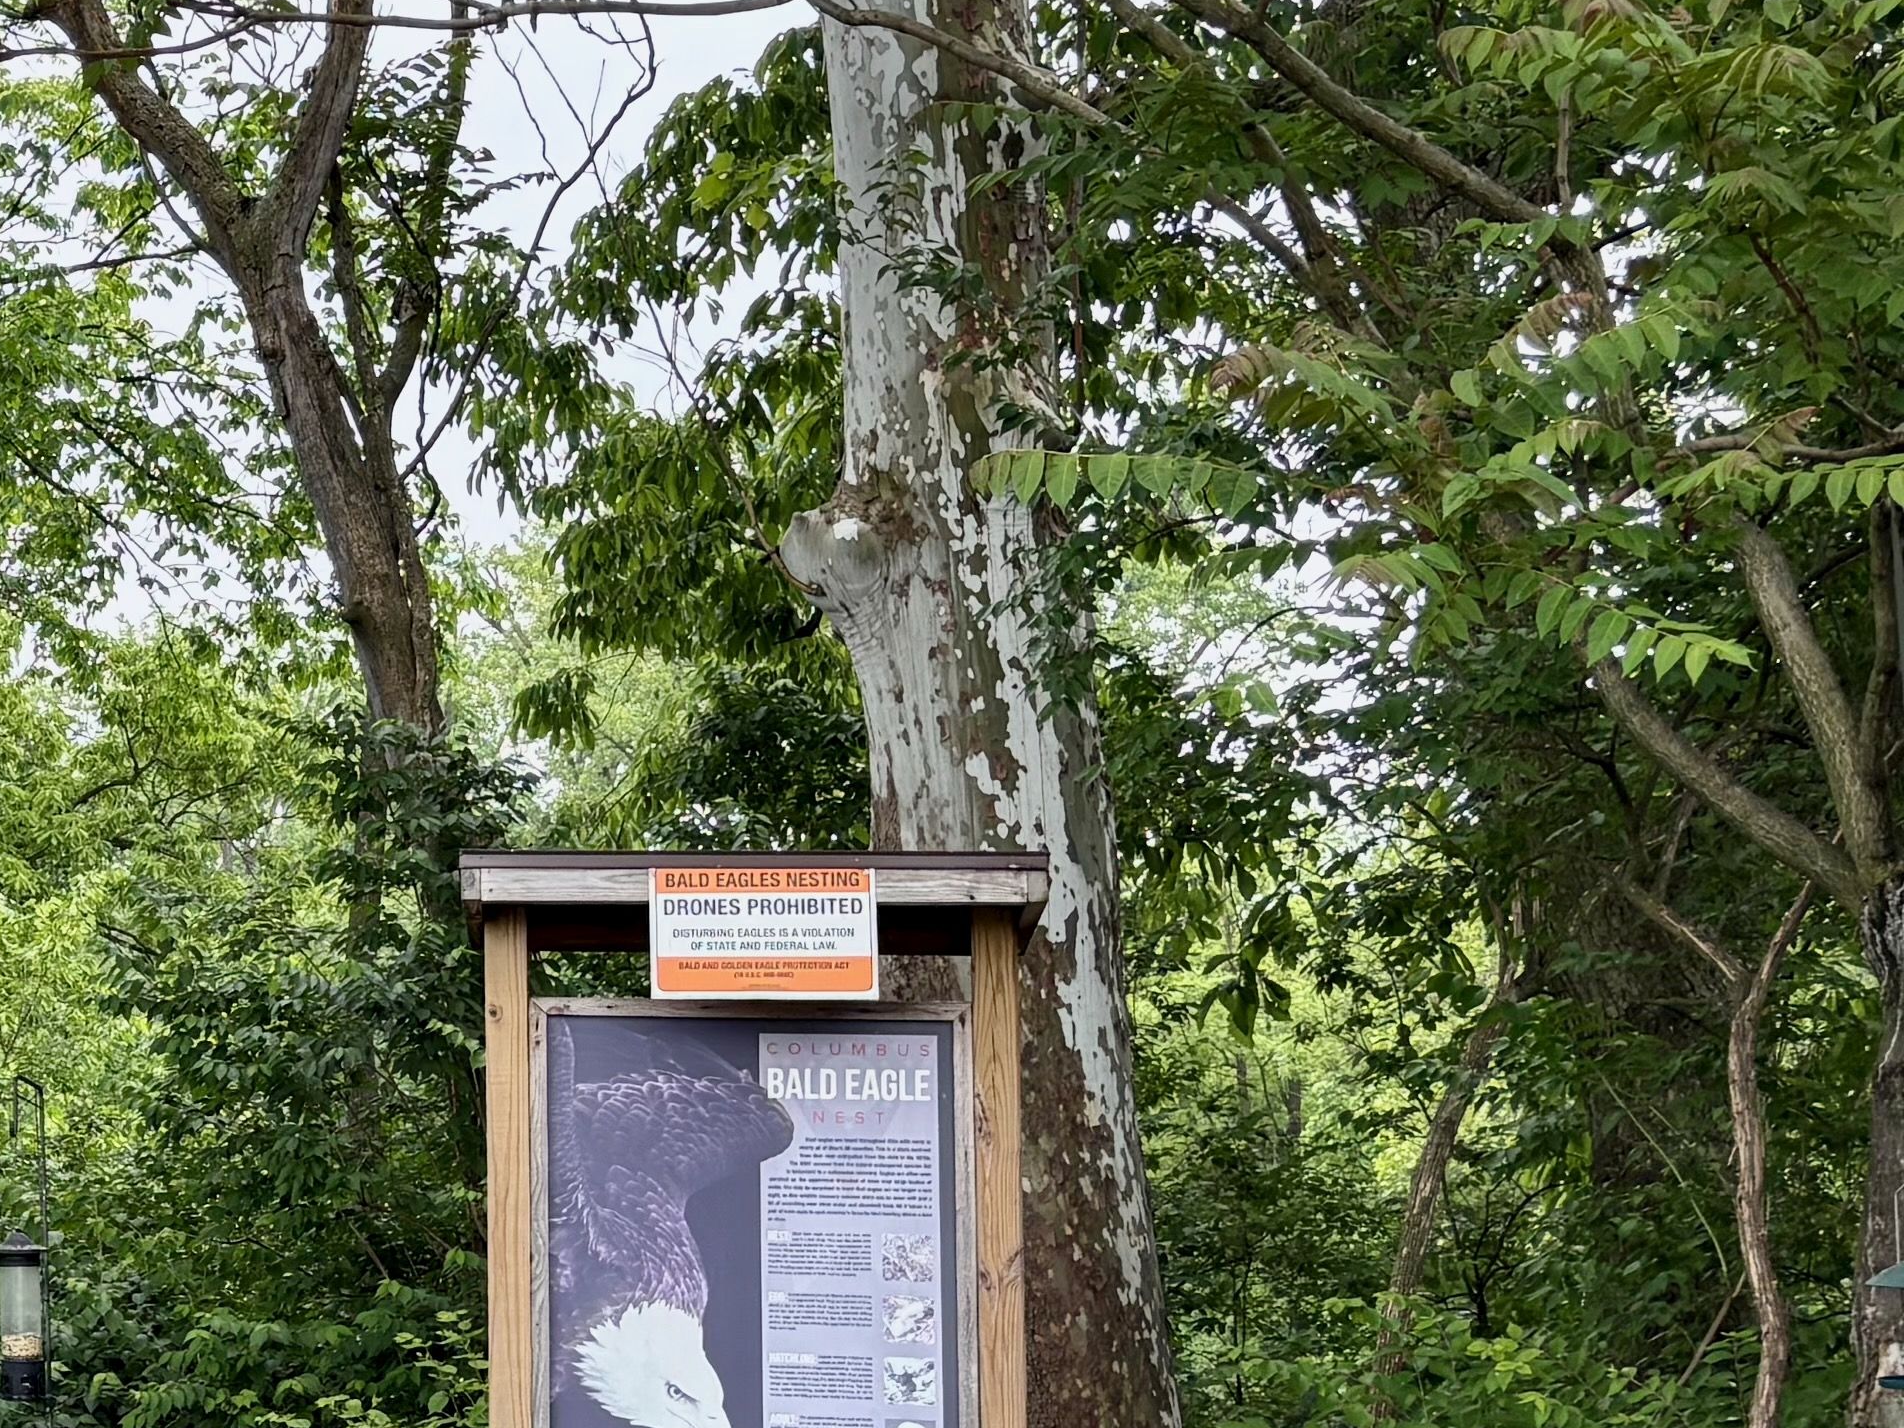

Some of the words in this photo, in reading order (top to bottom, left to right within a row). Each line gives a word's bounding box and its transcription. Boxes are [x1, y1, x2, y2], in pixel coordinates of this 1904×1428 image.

[666, 874, 709, 888] BALD
[717, 873, 780, 887] EAGLES
[787, 872, 859, 886] NESTING
[664, 899, 740, 915] DRONES
[748, 898, 862, 914] PROHIBITED
[673, 928, 734, 937] DISTURBING
[738, 928, 775, 937] EAGLES
[779, 928, 788, 937] IS
[792, 928, 798, 937] A
[802, 928, 854, 937] VIOLATION
[691, 942, 704, 950] OF
[707, 942, 736, 950] STATE
[740, 942, 760, 950] AND
[764, 942, 809, 950] FEDERAL
[813, 942, 836, 950] LAW.
[679, 962, 700, 970] BALD
[702, 962, 718, 970] AND
[721, 962, 753, 970] GOLDEN
[756, 962, 780, 970] EAGLE
[783, 962, 832, 970] PROTECTION
[767, 1042, 930, 1057] COLUMBUS
[767, 1068, 837, 1101] BALD
[846, 1068, 931, 1101] EAGLE
[813, 1111, 885, 1125] NEST
